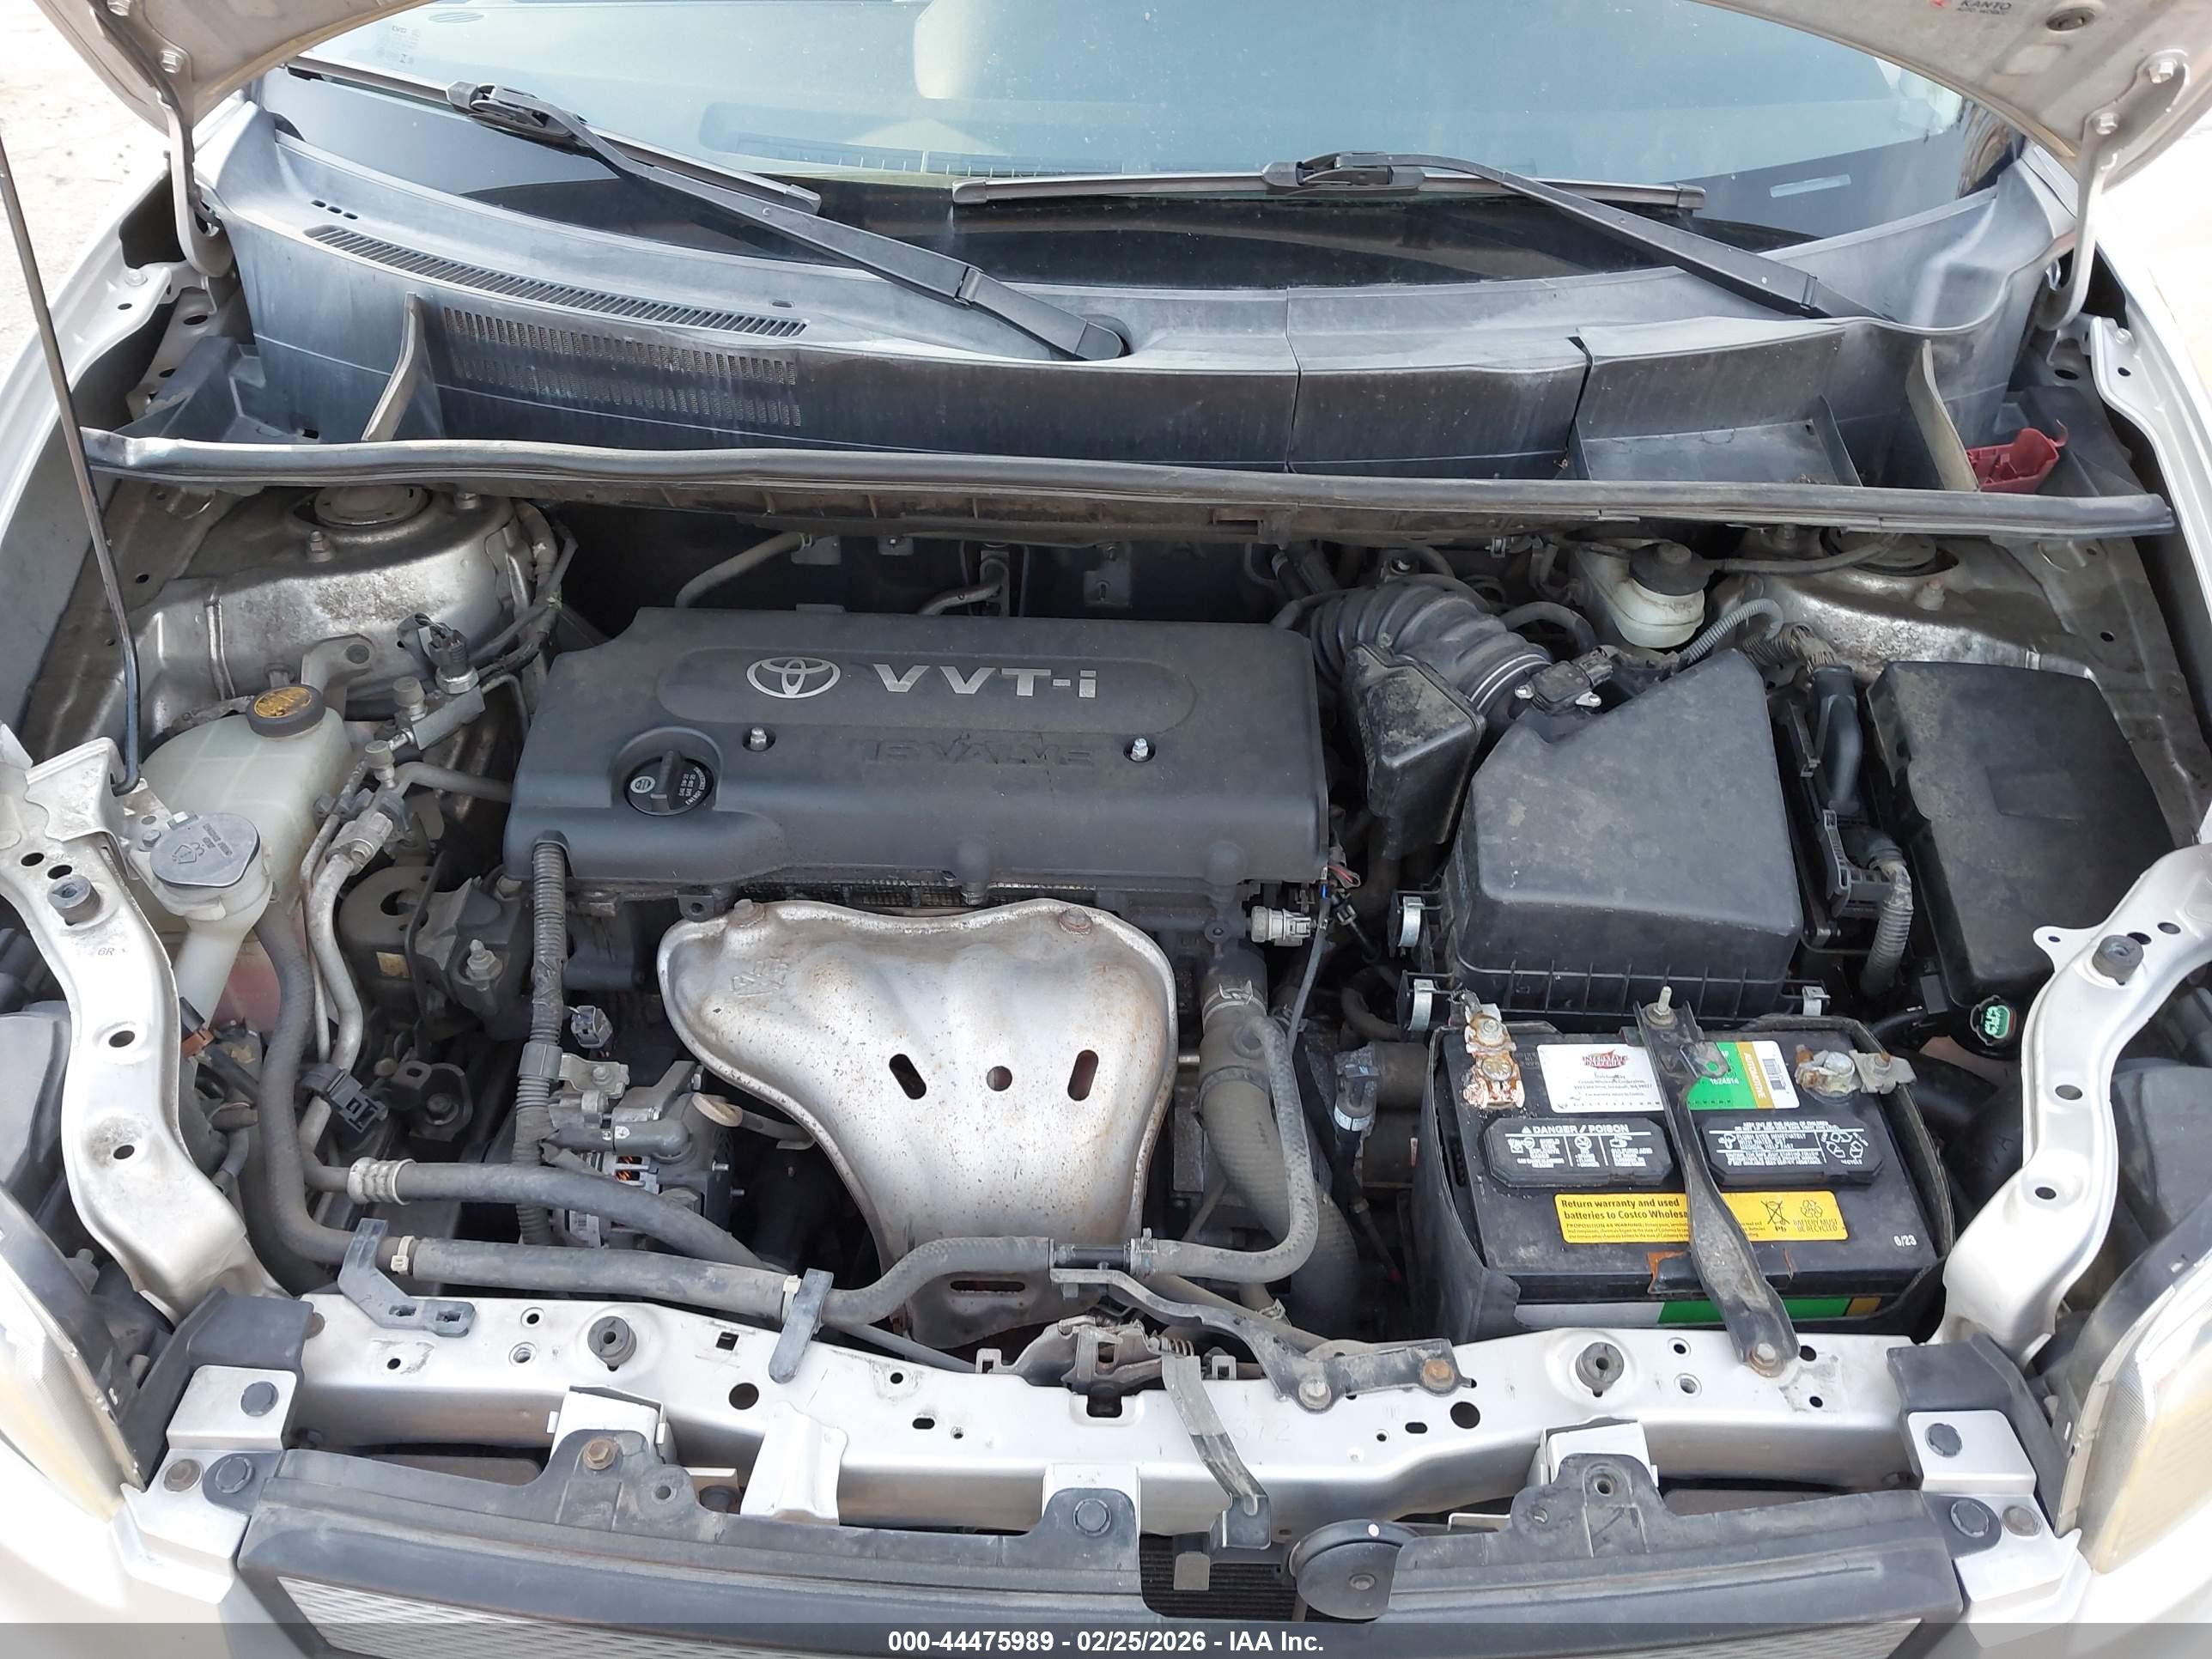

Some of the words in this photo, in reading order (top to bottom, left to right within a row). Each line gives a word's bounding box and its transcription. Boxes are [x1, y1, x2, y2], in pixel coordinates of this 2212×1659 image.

[1960, 0, 2012, 9] KANTO
[873, 662, 1098, 699] VVT-i
[1533, 1125, 1578, 1133] DANGER
[1588, 1124, 1630, 1133] POISON
[1595, 1199, 1636, 1209] warranty
[1657, 1198, 1680, 1206] used
[1564, 1210, 1605, 1219] batteries
[1607, 1211, 1616, 1219] to
[1618, 1210, 1648, 1218] Costco
